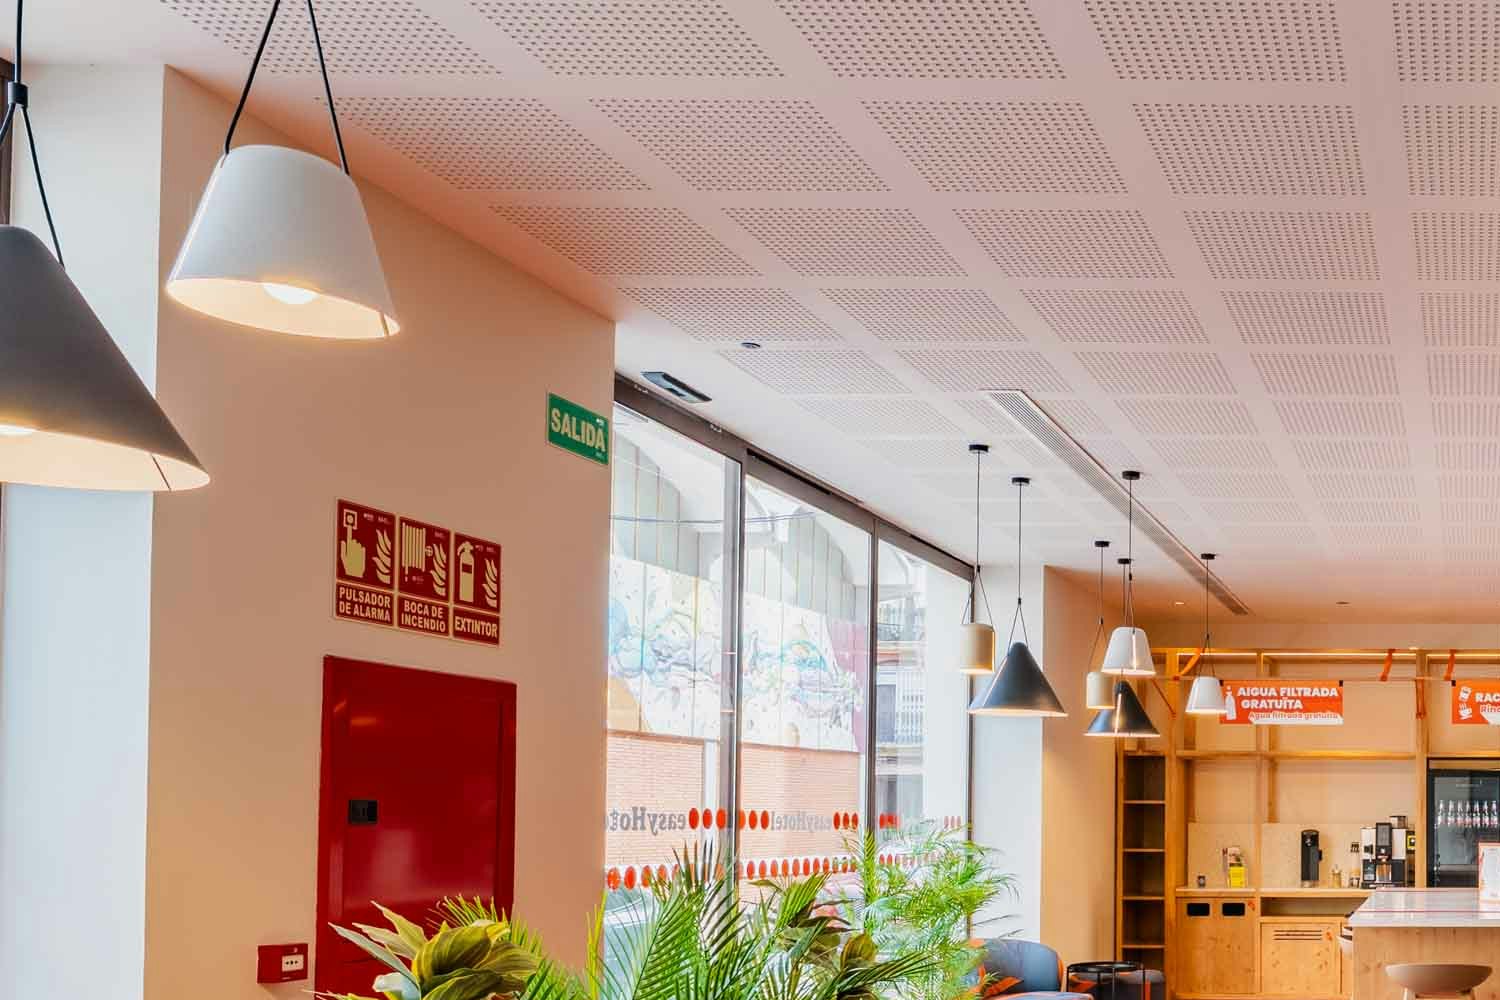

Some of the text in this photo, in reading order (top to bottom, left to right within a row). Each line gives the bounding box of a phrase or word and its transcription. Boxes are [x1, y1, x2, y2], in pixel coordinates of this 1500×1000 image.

[551, 407, 606, 452] SALIDA
[339, 586, 391, 609] PULSADOR
[339, 601, 391, 622] DE ALARMA
[404, 600, 444, 619] BOCA DE
[401, 613, 446, 633] INCENDIO
[454, 616, 498, 639] EXTINTOR
[1237, 687, 1338, 697] AIGUA FILTRADA
